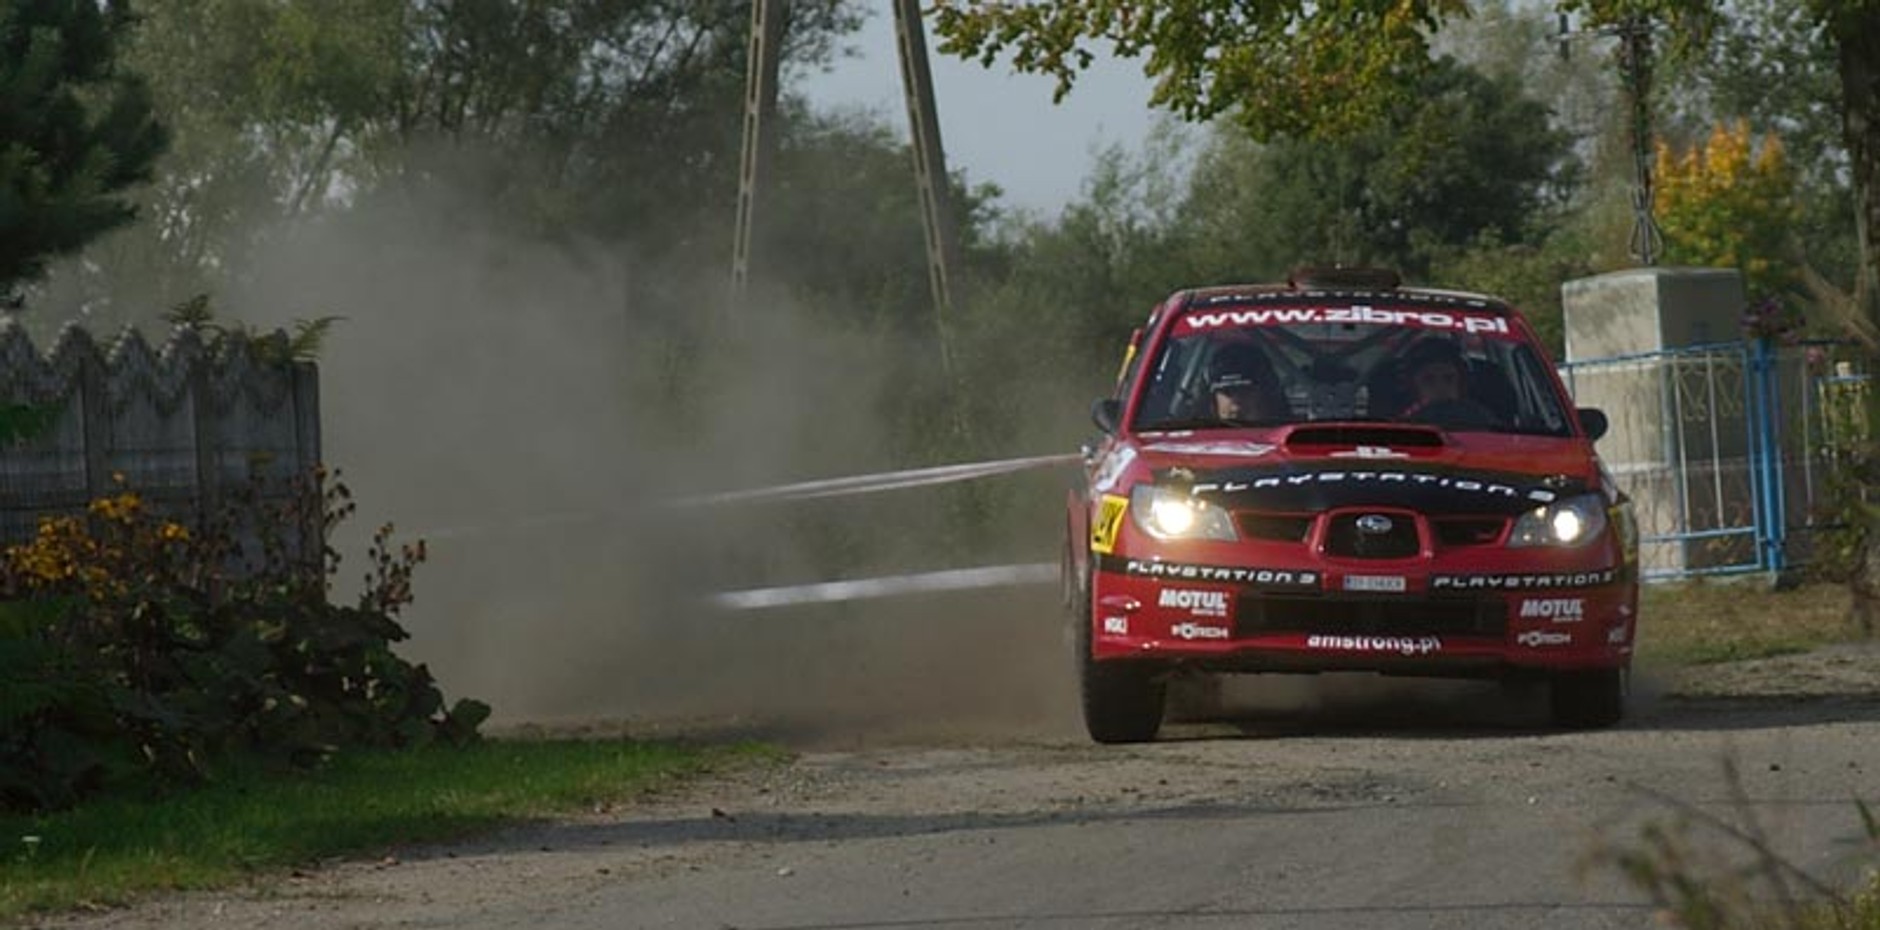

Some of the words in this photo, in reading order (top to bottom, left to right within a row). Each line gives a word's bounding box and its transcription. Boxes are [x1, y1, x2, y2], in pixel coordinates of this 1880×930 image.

[1187, 305, 1508, 333] www.zibro.pl
[1192, 472, 1517, 495] PLAYSTATION
[1127, 561, 1291, 583] PLAYSTATION
[1299, 574, 1315, 584] 3
[1433, 573, 1599, 588] PLAYSTATION
[1158, 589, 1228, 609] MOTUL
[1520, 599, 1584, 617] MOTUL
[1307, 634, 1441, 655] amstrong.pl
